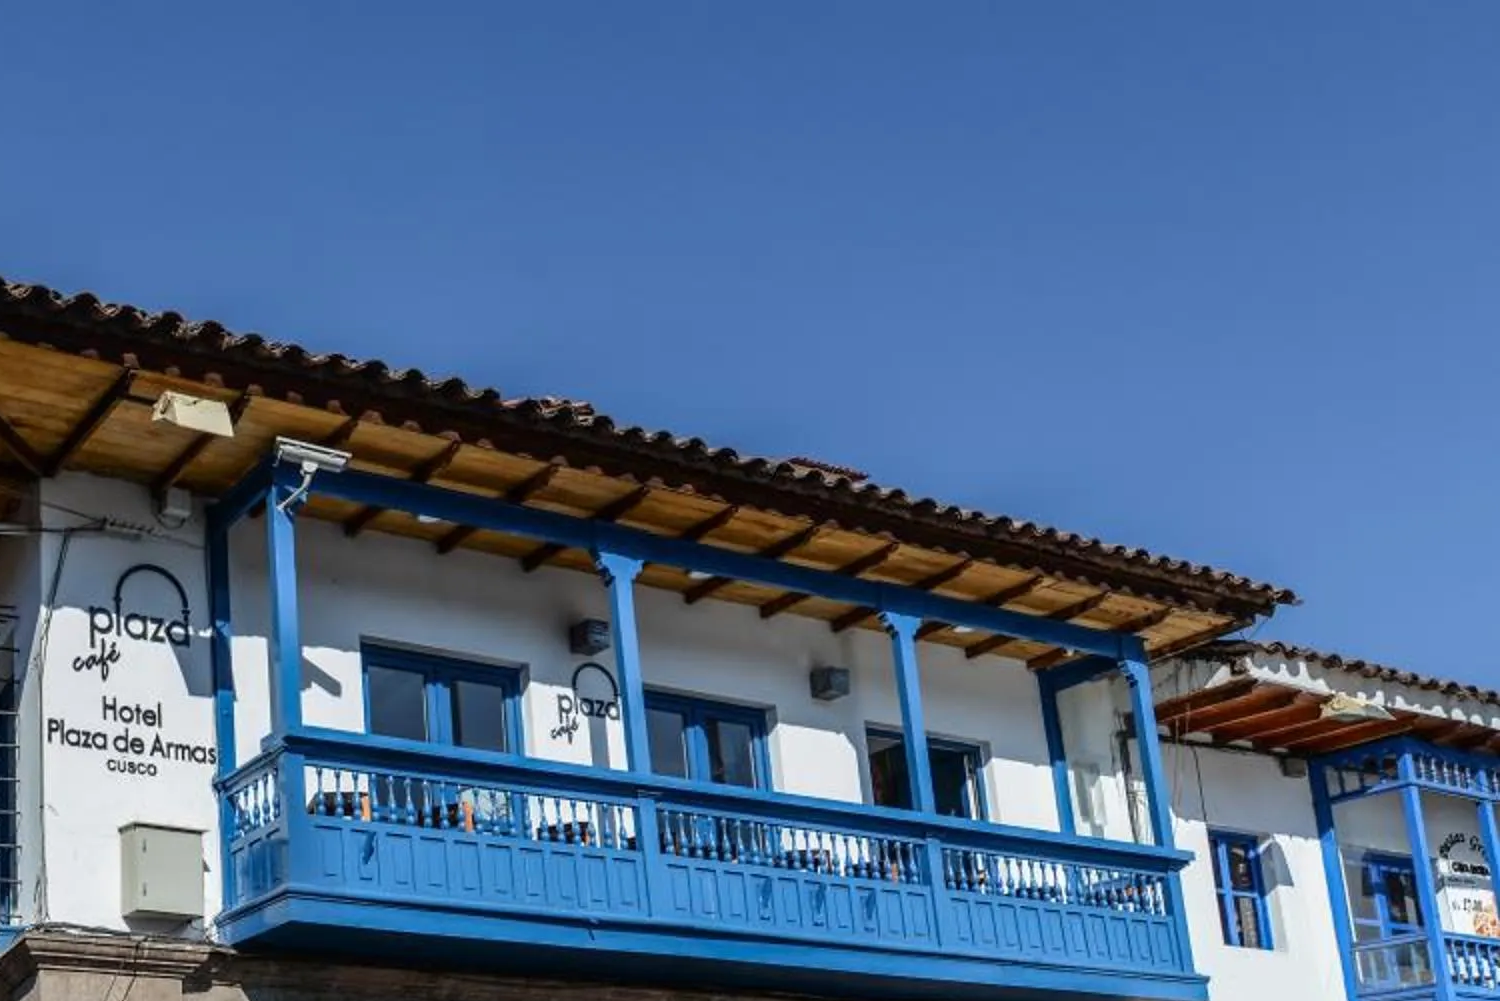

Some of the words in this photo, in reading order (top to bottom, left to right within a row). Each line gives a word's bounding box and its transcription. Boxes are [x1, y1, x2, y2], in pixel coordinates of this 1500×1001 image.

[88, 594, 190, 648] plaza
[72, 638, 121, 681] café
[102, 695, 162, 729] Hotel
[557, 684, 620, 724] plaza
[47, 718, 108, 750] Plaza
[113, 728, 144, 755] de
[149, 733, 217, 765] Armas
